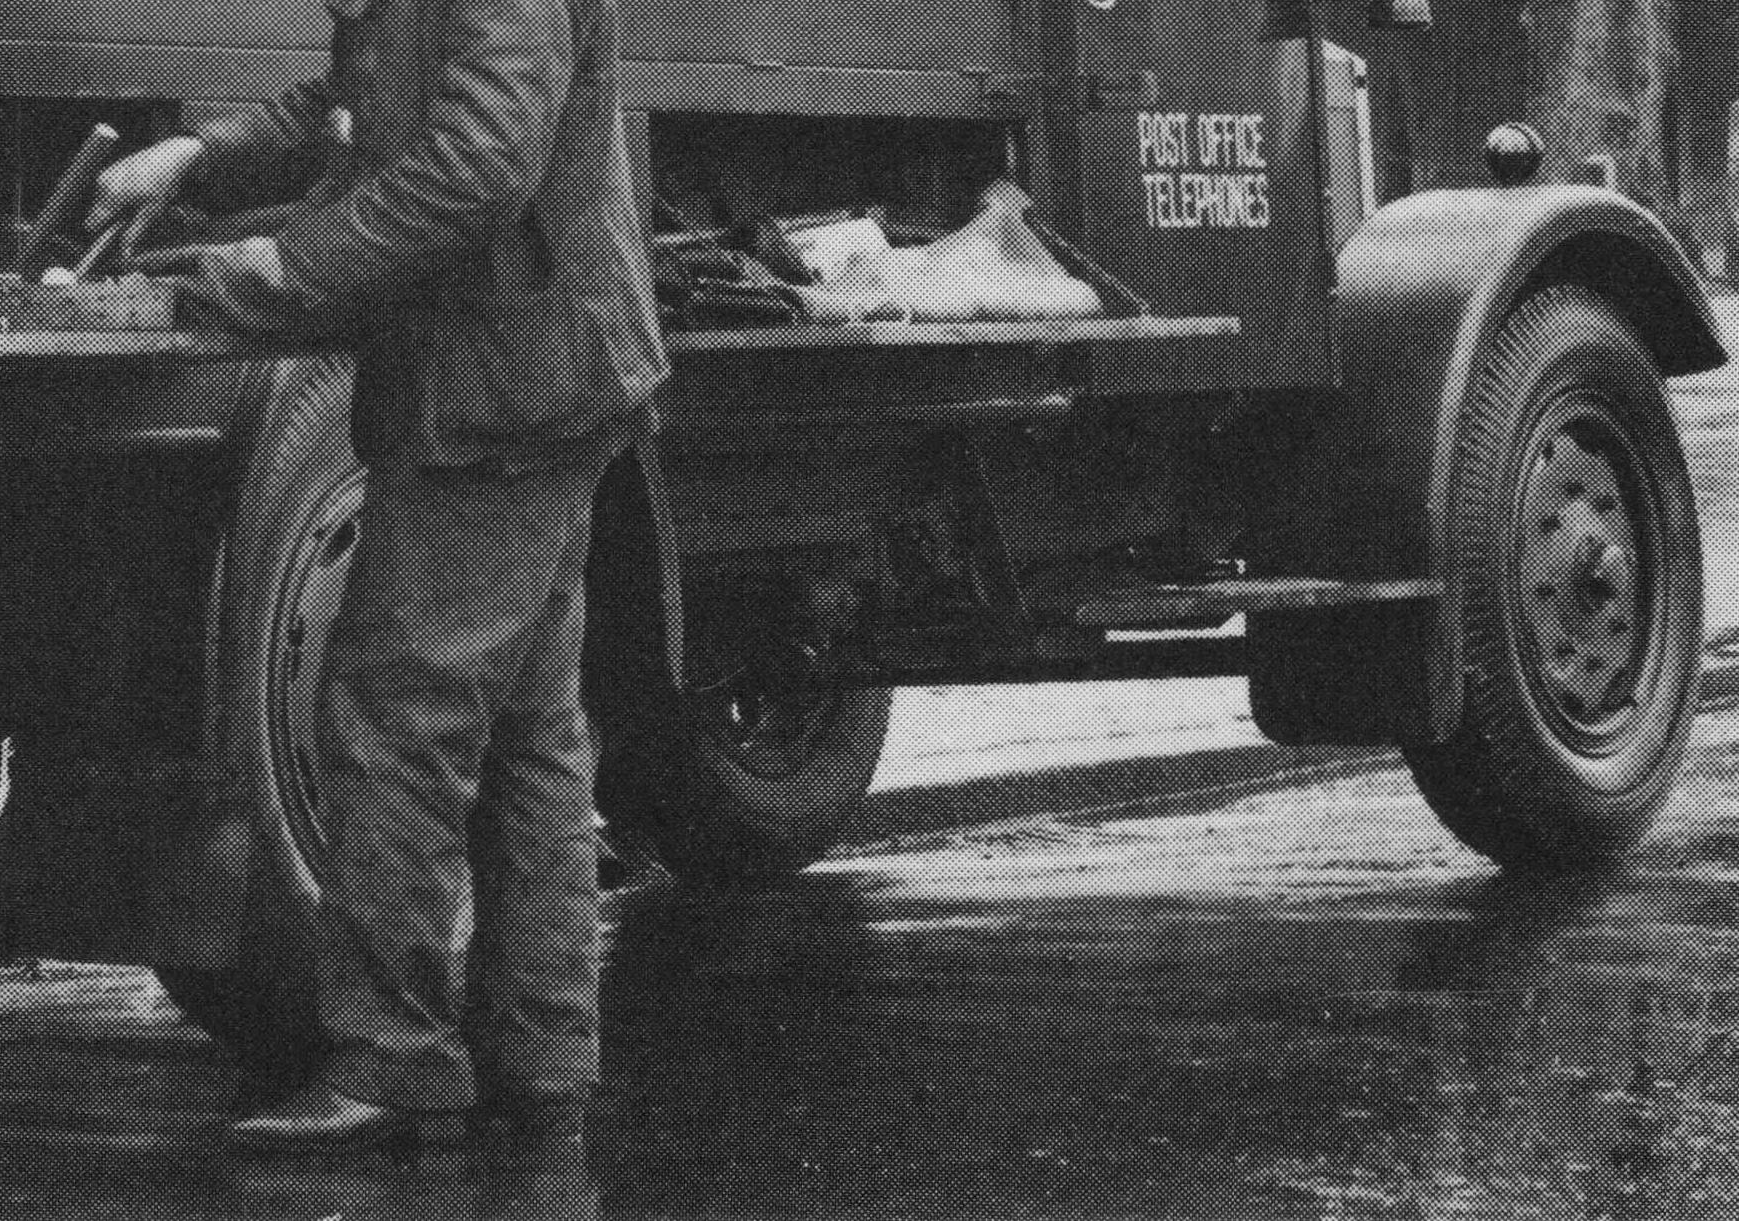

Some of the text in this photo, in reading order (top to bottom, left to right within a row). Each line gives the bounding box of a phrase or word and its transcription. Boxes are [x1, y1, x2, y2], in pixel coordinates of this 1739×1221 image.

[1136, 111, 1267, 168] POST OFFICE
[1141, 174, 1270, 228] TELEPHONES
